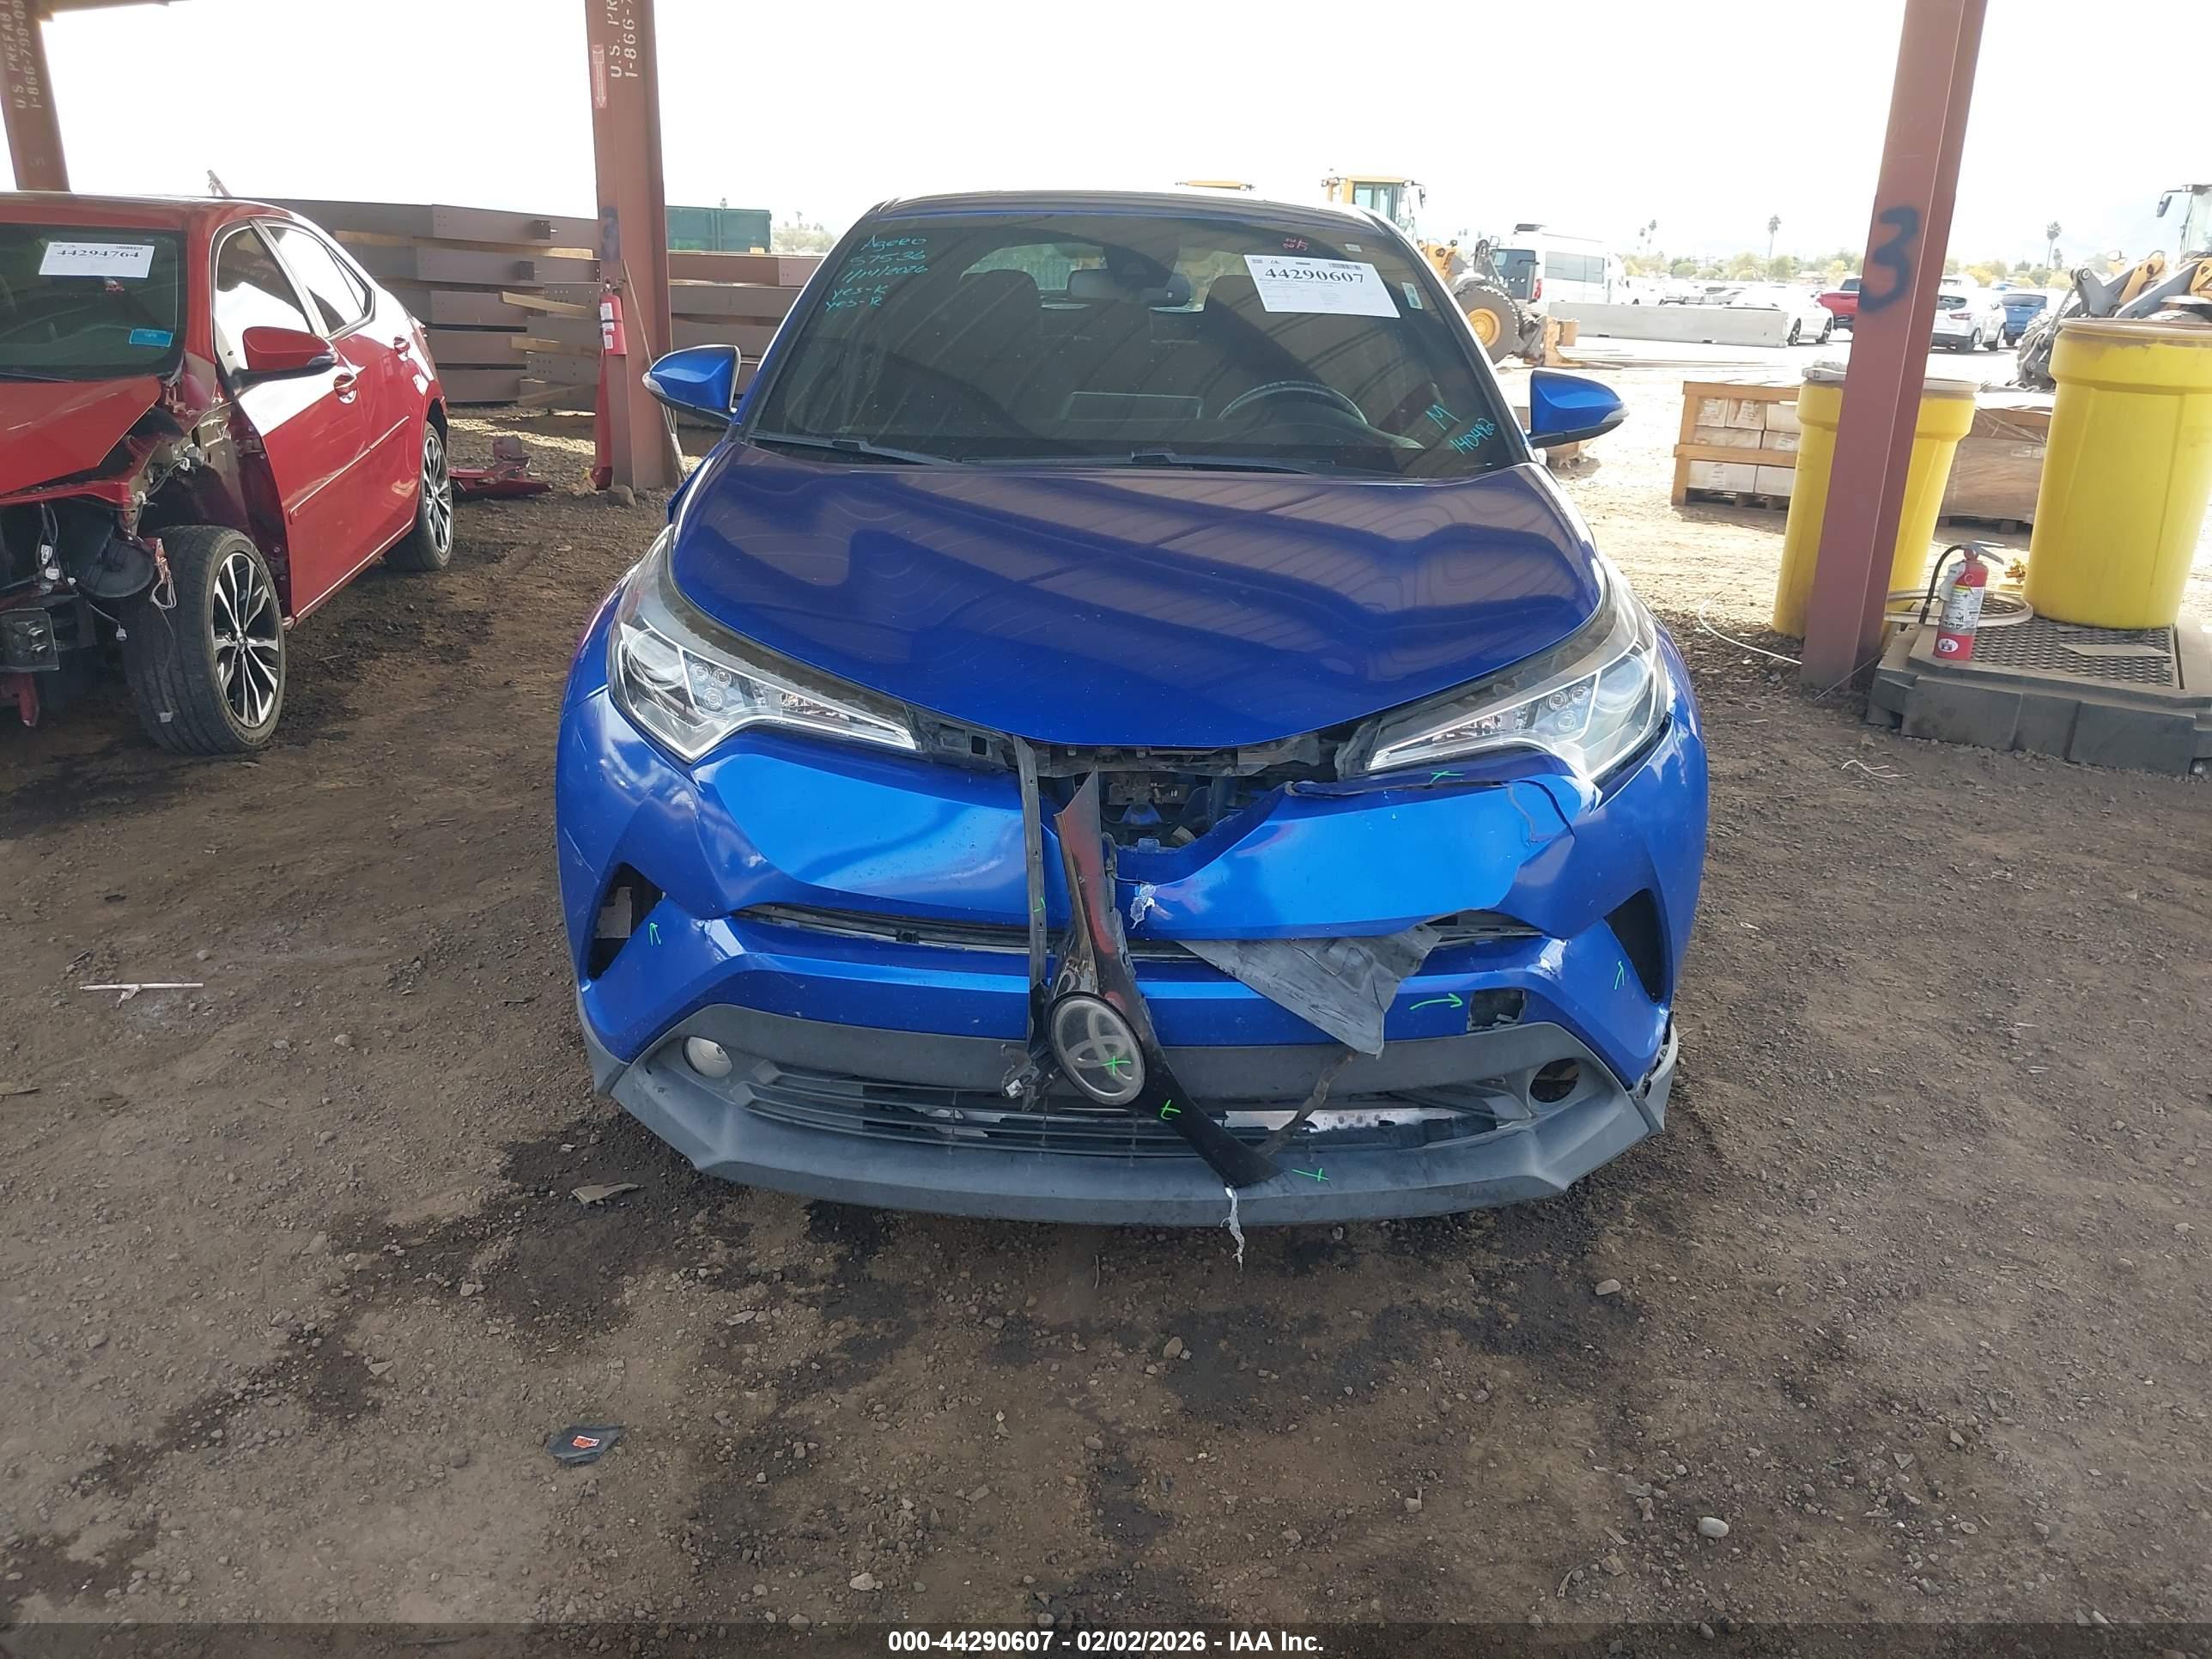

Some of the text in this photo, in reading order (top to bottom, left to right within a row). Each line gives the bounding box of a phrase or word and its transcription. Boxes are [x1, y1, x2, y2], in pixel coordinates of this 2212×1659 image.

[57, 249, 140, 258] 44294764
[1860, 205, 1919, 313] 3
[1264, 268, 1364, 283] 44290607
